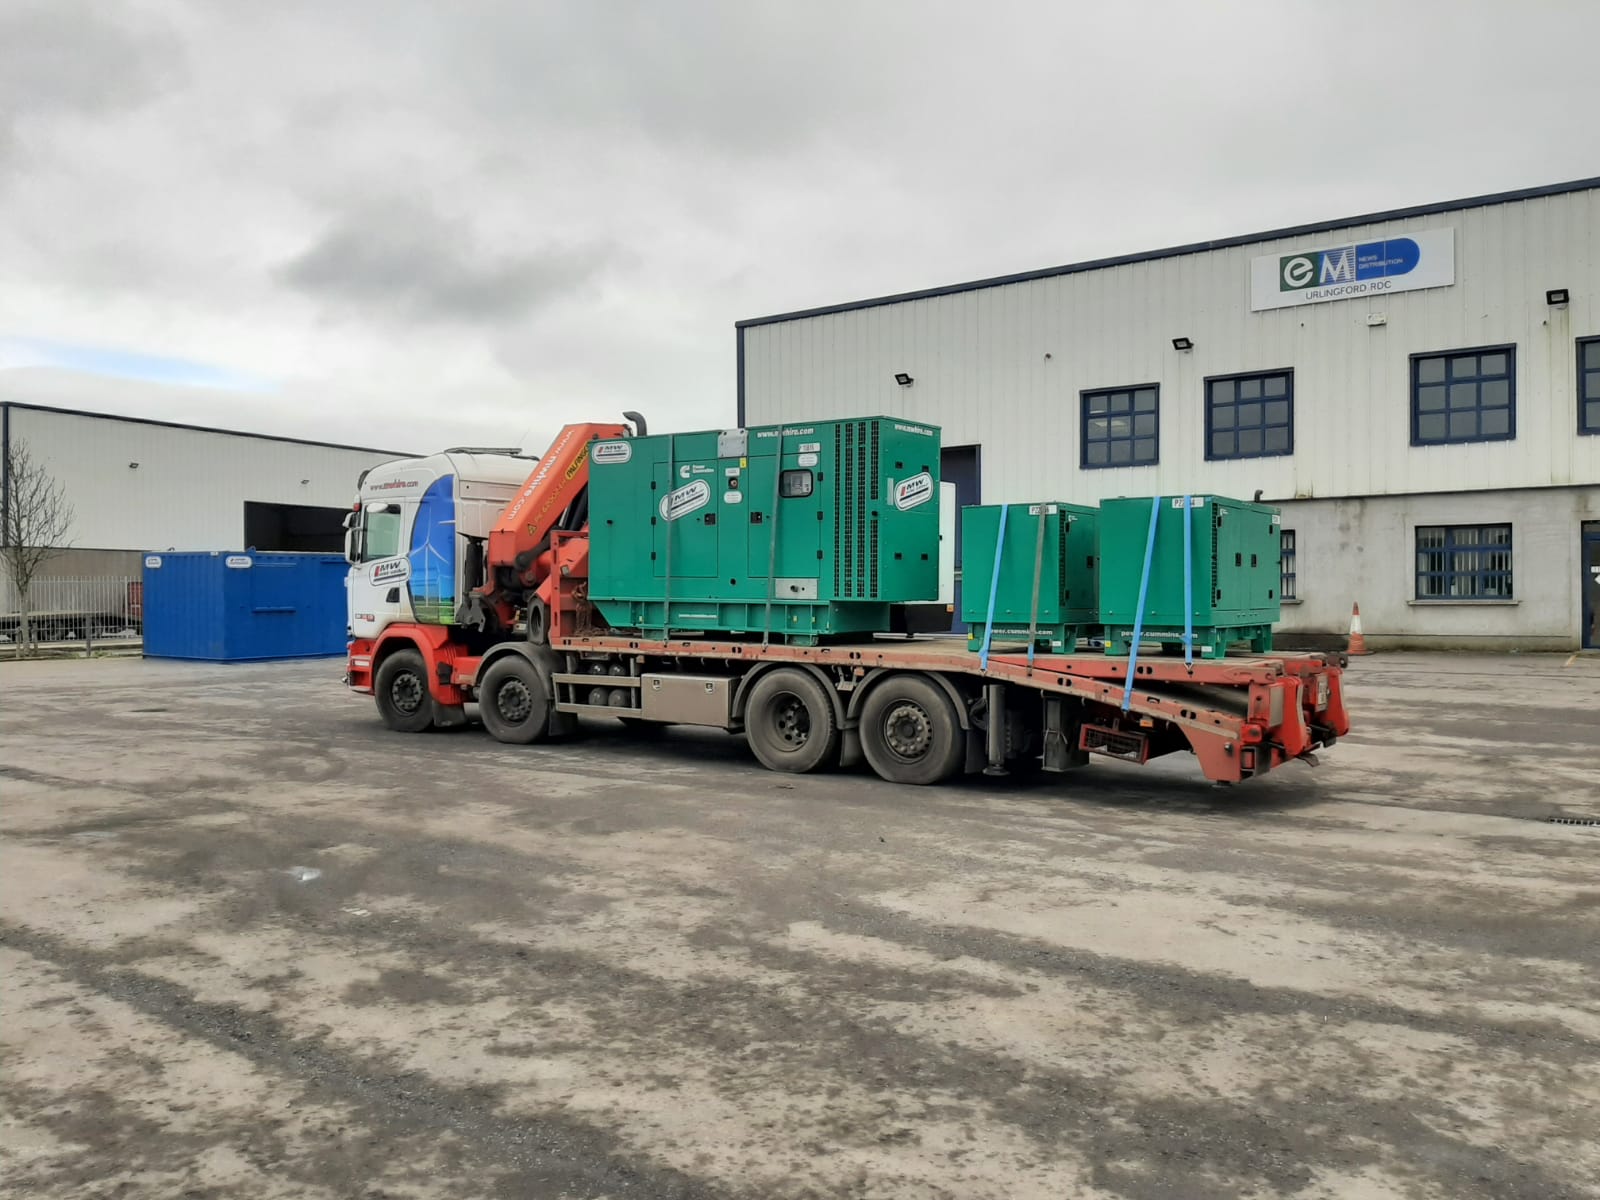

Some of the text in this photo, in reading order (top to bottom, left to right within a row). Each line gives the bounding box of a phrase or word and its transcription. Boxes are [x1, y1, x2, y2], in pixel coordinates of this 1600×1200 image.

[1358, 255, 1378, 263] NEWS
[1358, 258, 1404, 270] DISTRIBUTION
[1305, 280, 1392, 300] URLINGFORD RDC
[906, 479, 925, 490] MW
[674, 486, 698, 502] MW
[380, 561, 401, 571] MW
